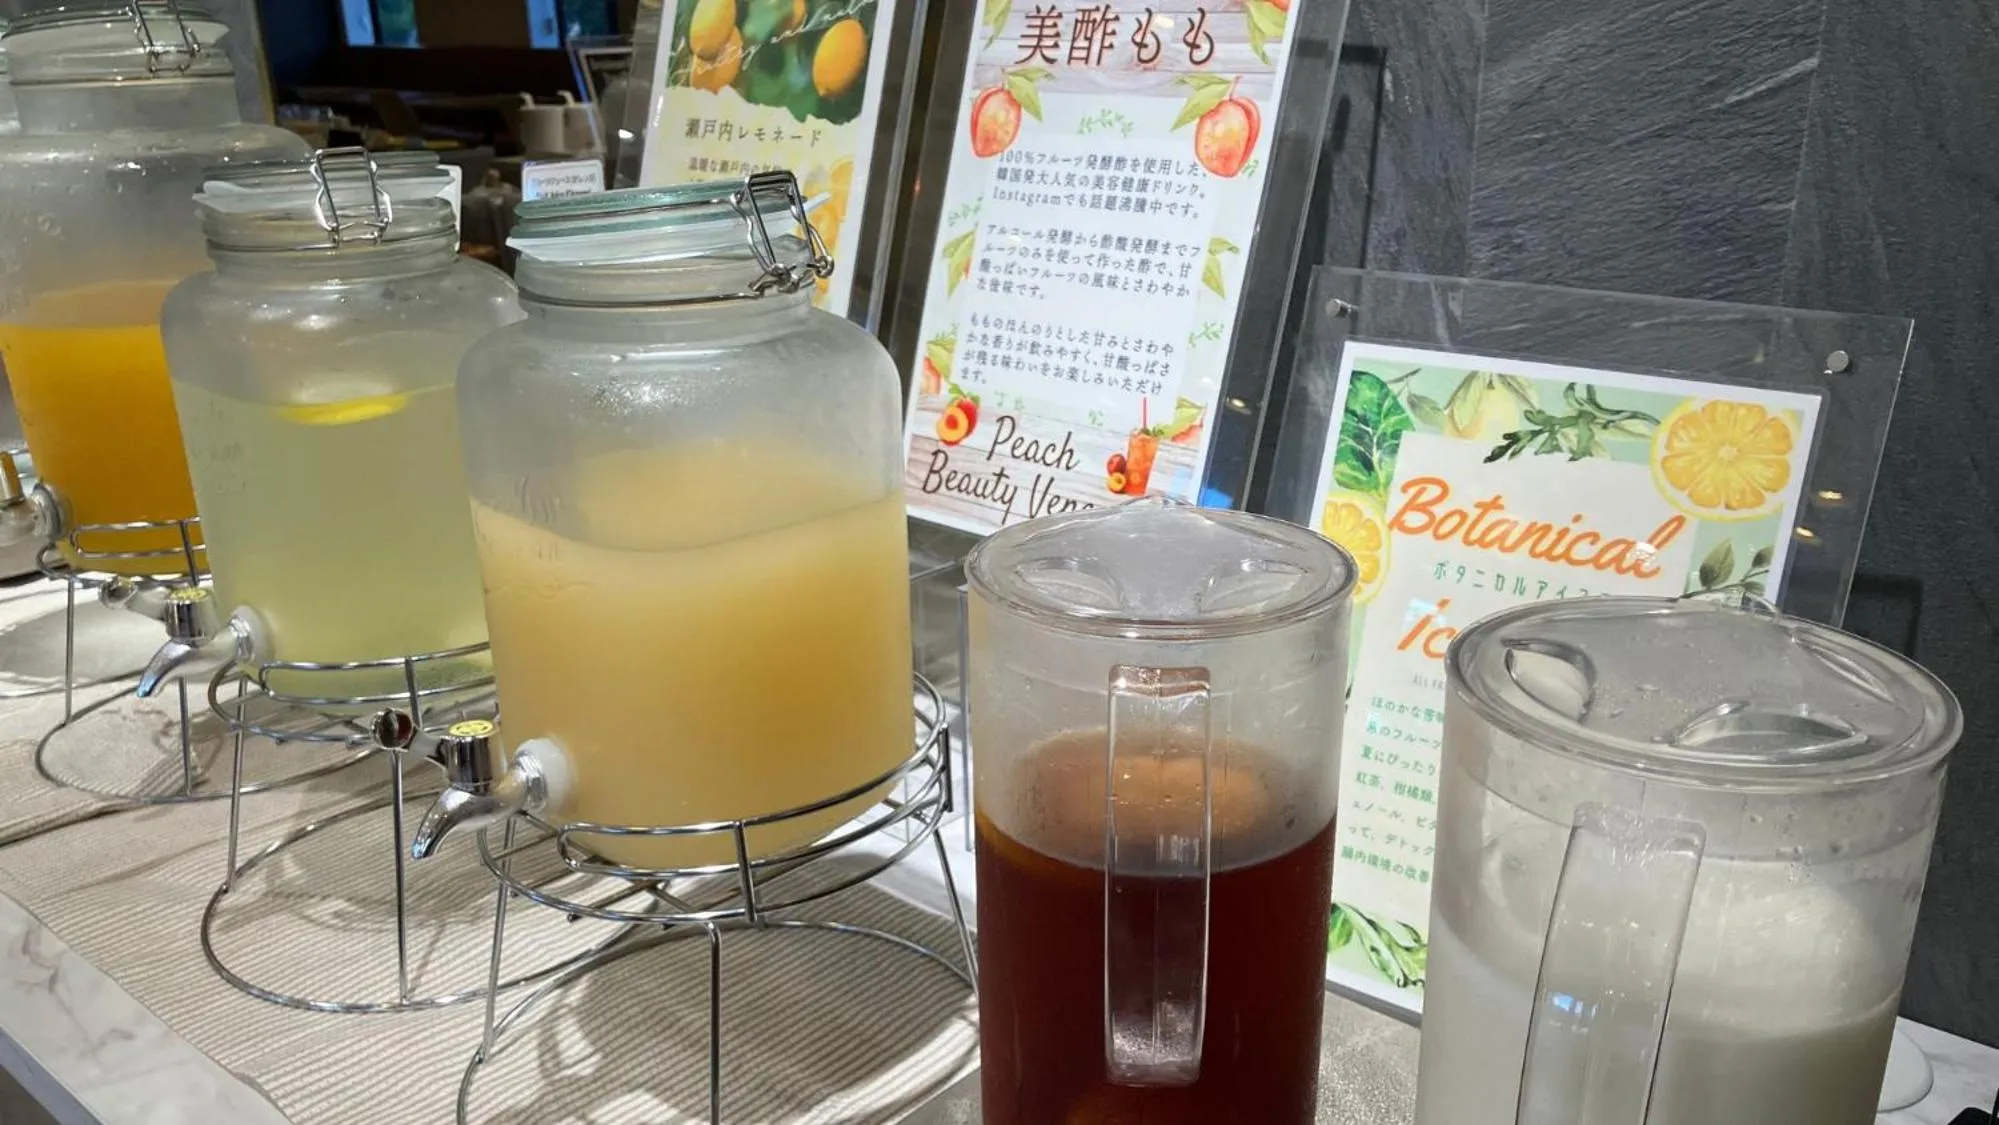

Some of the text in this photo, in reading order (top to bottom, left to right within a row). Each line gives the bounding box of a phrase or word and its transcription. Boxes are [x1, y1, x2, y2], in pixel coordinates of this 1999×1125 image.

[1014, 4, 1215, 66] 美酢もも
[685, 118, 822, 147] 瀬戸内レモネード
[986, 415, 1079, 471] Peach
[922, 449, 1018, 525] Beauty
[1387, 476, 1687, 578] Botanical
